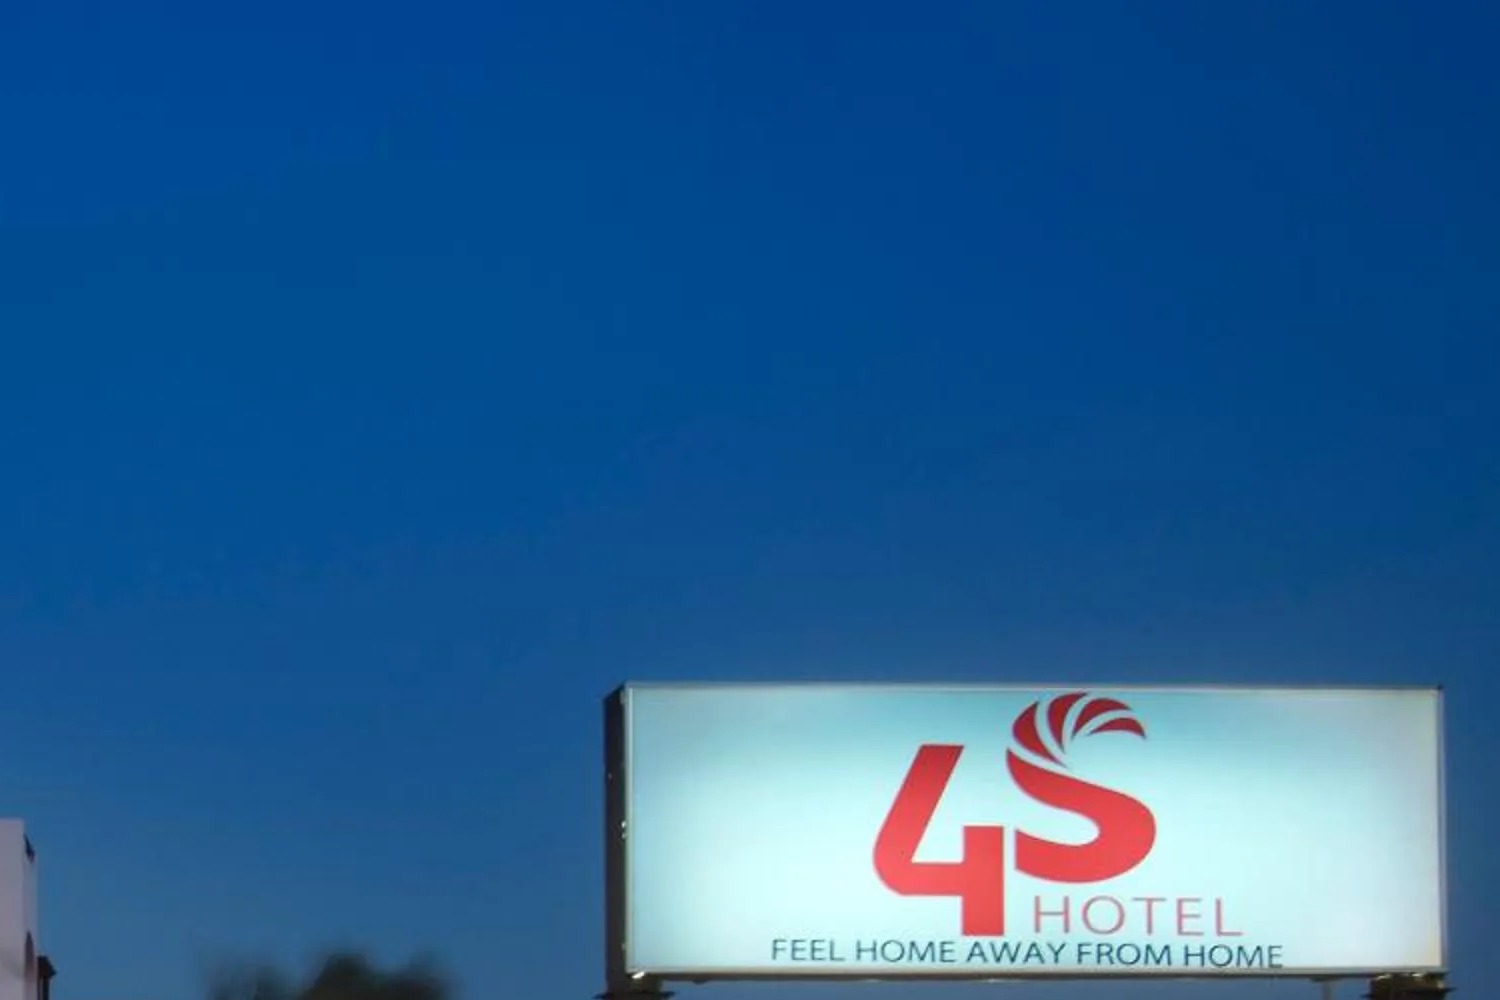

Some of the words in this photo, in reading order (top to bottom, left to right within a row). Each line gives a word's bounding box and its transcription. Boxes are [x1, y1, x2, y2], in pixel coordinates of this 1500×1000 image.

[873, 692, 1156, 937] 4S
[1033, 895, 1244, 937] HOTEL
[771, 938, 845, 962] FEEL
[855, 939, 957, 964] HOME
[966, 941, 1067, 965] AWAY
[1076, 942, 1172, 967] FROM
[1183, 944, 1284, 969] HOME
